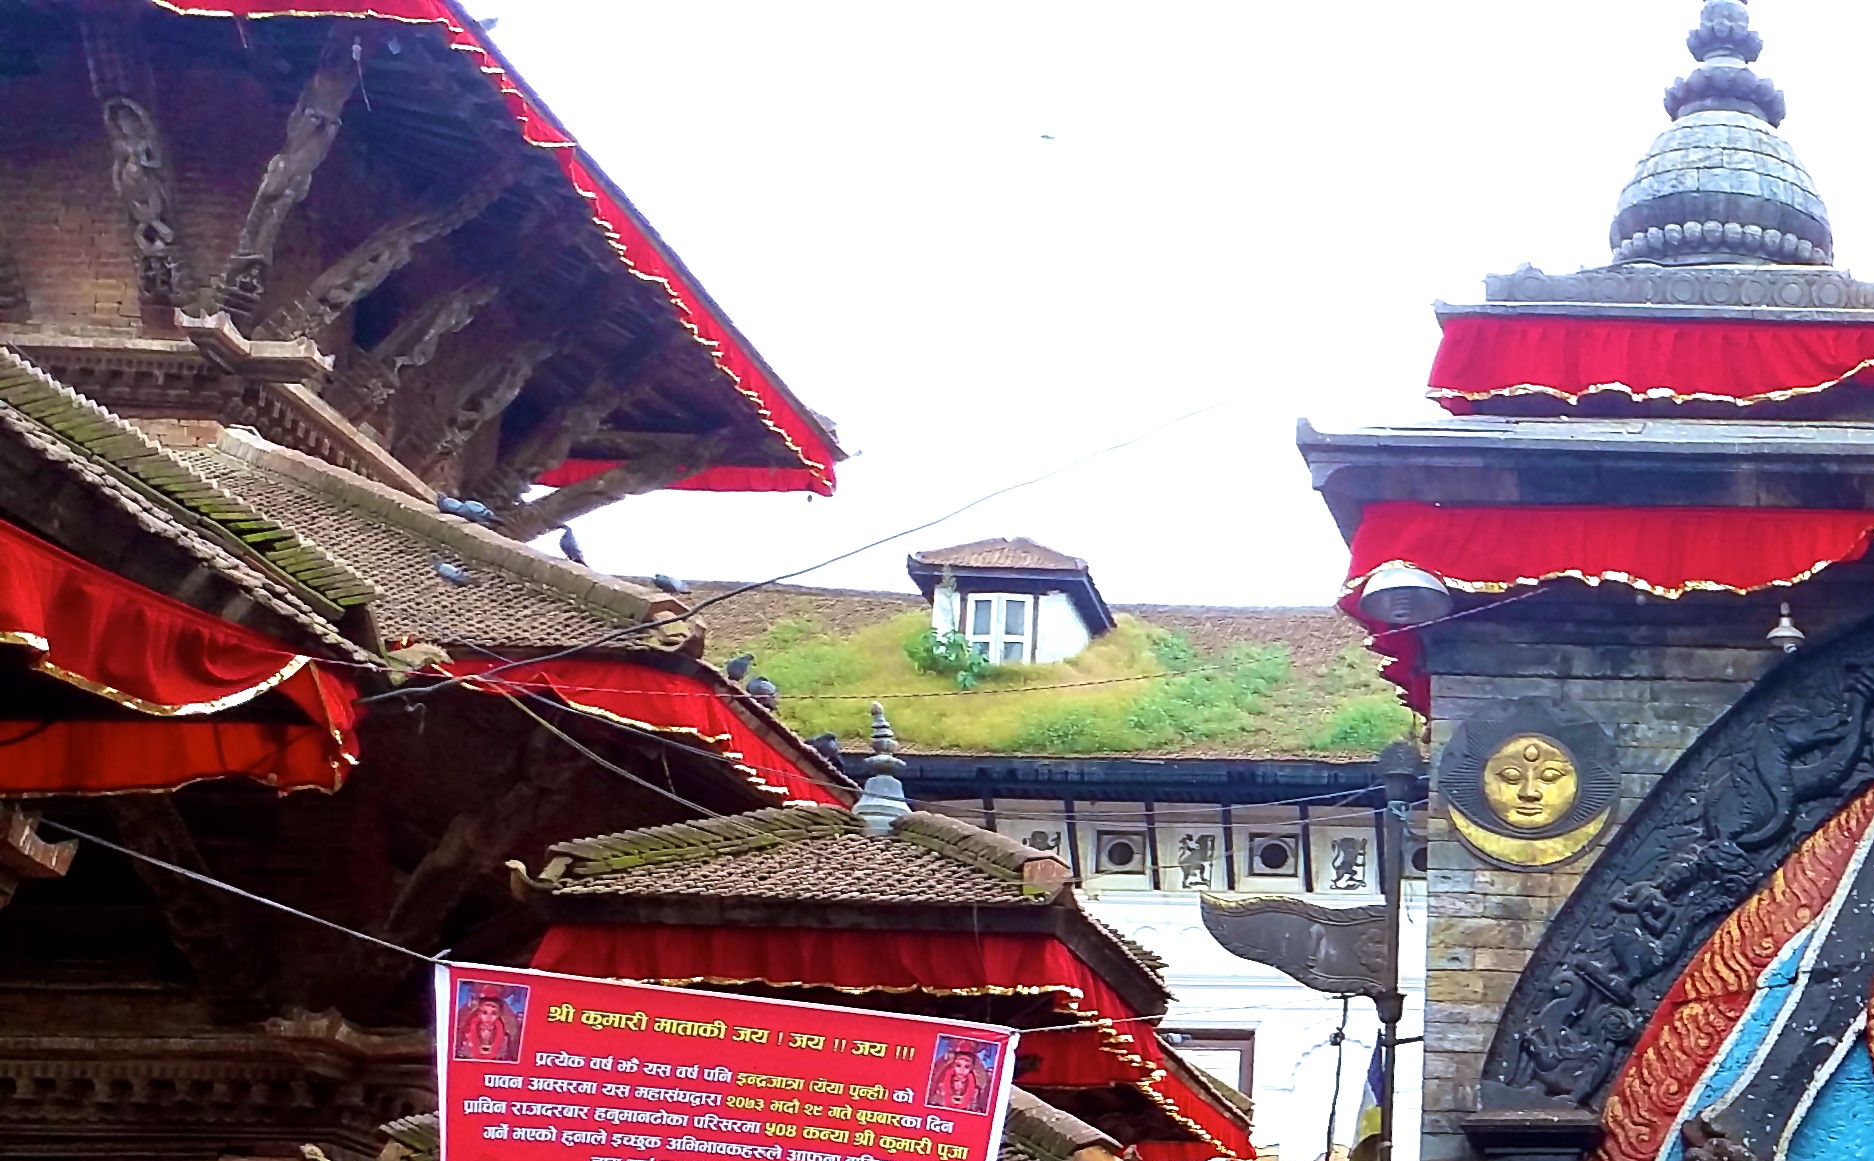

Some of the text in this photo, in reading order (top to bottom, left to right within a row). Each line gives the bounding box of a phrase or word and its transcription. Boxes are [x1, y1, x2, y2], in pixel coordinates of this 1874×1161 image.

[547, 1003, 576, 1023] श्री
[580, 1010, 649, 1031] कुमारी
[653, 1017, 728, 1040] माताकी
[732, 1026, 771, 1044] जय
[788, 1032, 826, 1051] जय
[851, 1040, 889, 1058] जय
[483, 1074, 524, 1089] पावन
[527, 1077, 599, 1095] अवसरमा
[601, 1083, 631, 1098] यस
[634, 1086, 723, 1107] महासंघद्वारा
[725, 1095, 765, 1112] २०७३
[769, 1098, 801, 1115] भदौ
[803, 1103, 824, 1116] २९
[827, 1103, 853, 1120] गते
[925, 1114, 955, 1134] दिन
[535, 1050, 586, 1068] प्रत्येक
[589, 1055, 614, 1071] वर्ष
[642, 1062, 672, 1078] यस
[675, 1064, 700, 1080] वर्ष
[703, 1066, 733, 1083] पनि
[735, 1072, 806, 1091] इन्द्रजात्रा
[892, 1087, 915, 1104] को
[463, 1096, 969, 1161] प्राचिन राजदरबार हनुमानढोका परिसरमा ५०४ कन्या श्री कुमारी पुजा
[512, 1125, 558, 1142] भएको
[560, 1128, 608, 1147] हुनाले
[610, 1133, 663, 1151] इच्छुक
